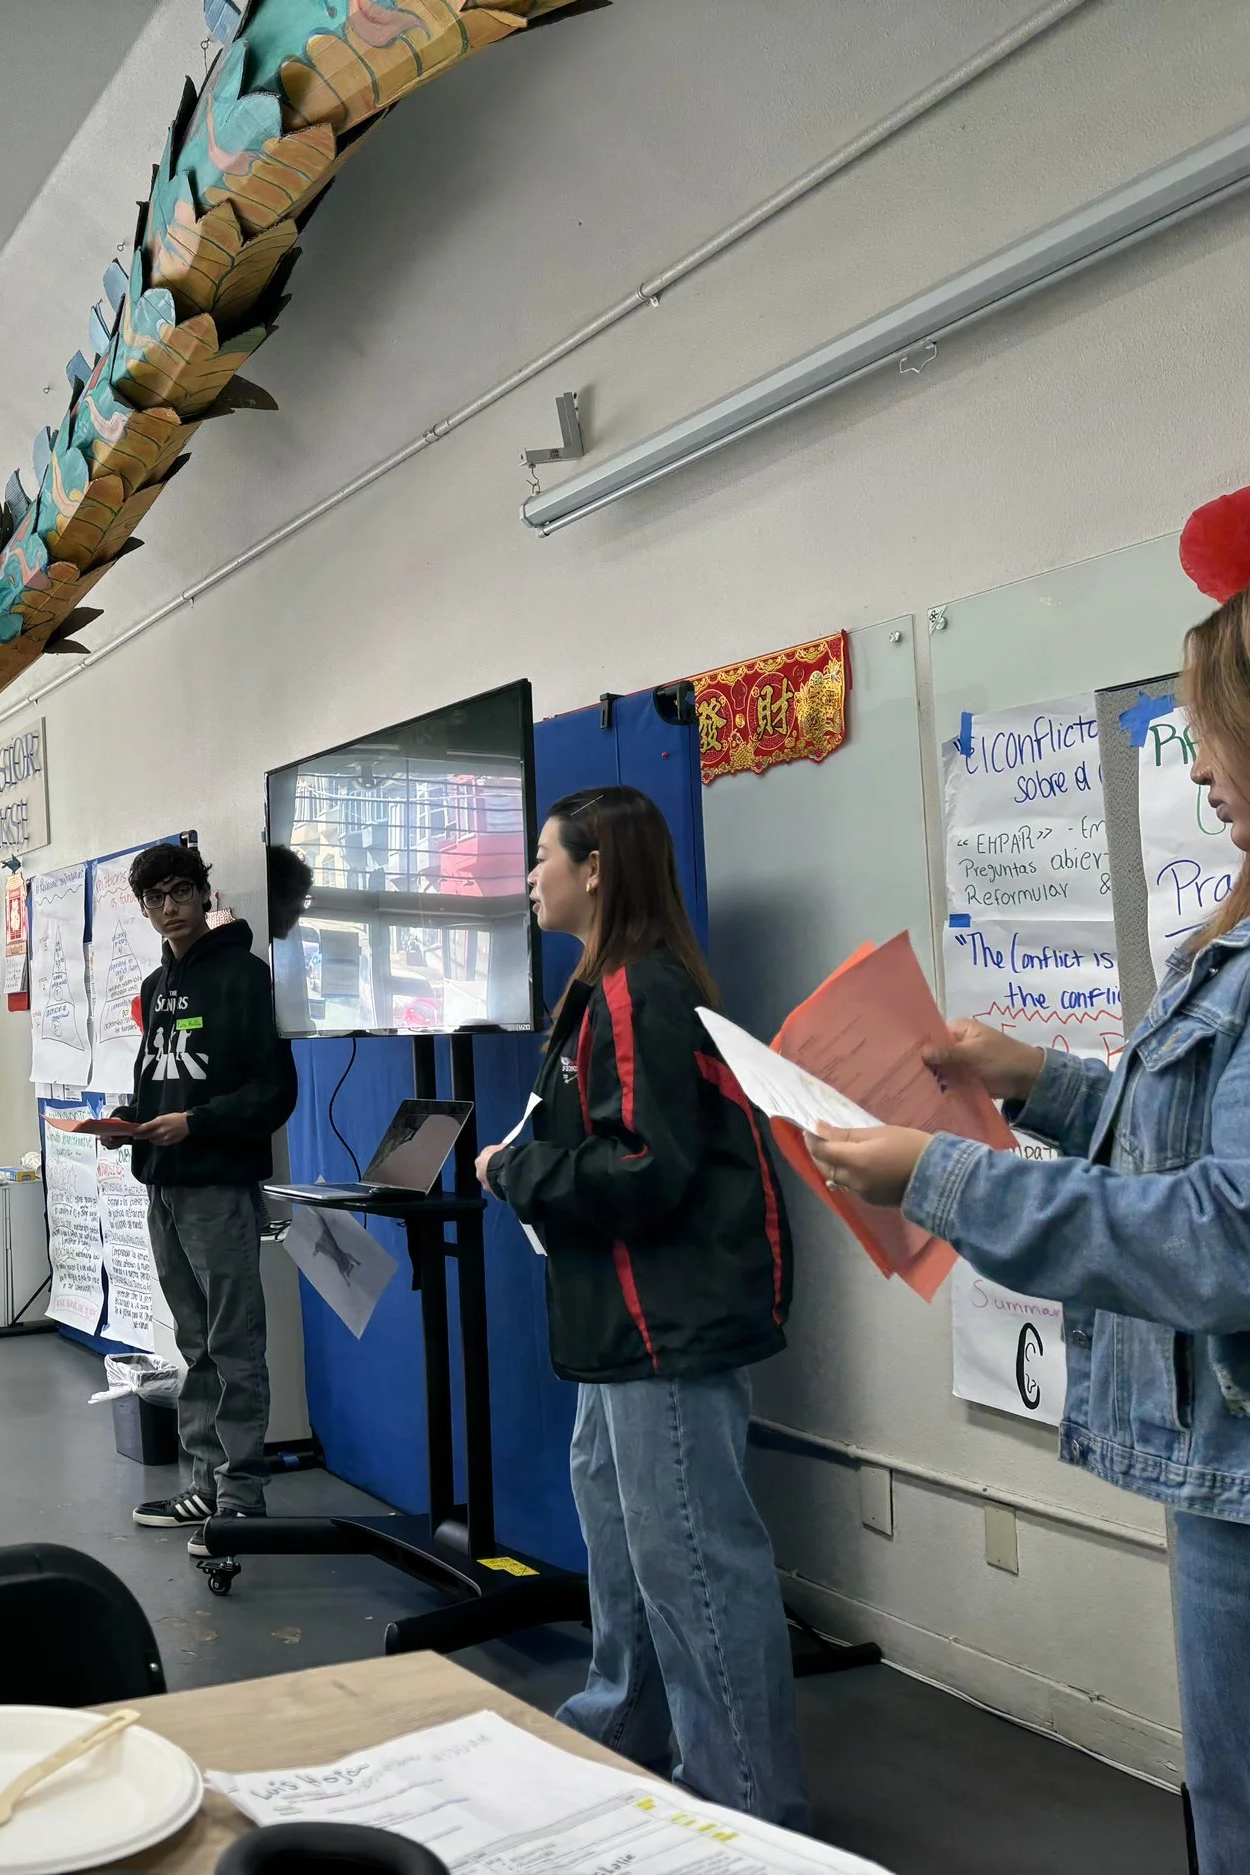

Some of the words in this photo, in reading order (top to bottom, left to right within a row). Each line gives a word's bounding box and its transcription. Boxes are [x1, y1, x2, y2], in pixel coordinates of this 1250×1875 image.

[1015, 770, 1068, 803] sobre
[959, 858, 1037, 882] Preguntas
[965, 884, 1069, 906] Reformular
[1011, 932, 1084, 973] Conflict
[1093, 952, 1115, 968] is
[1005, 982, 1050, 1009] the
